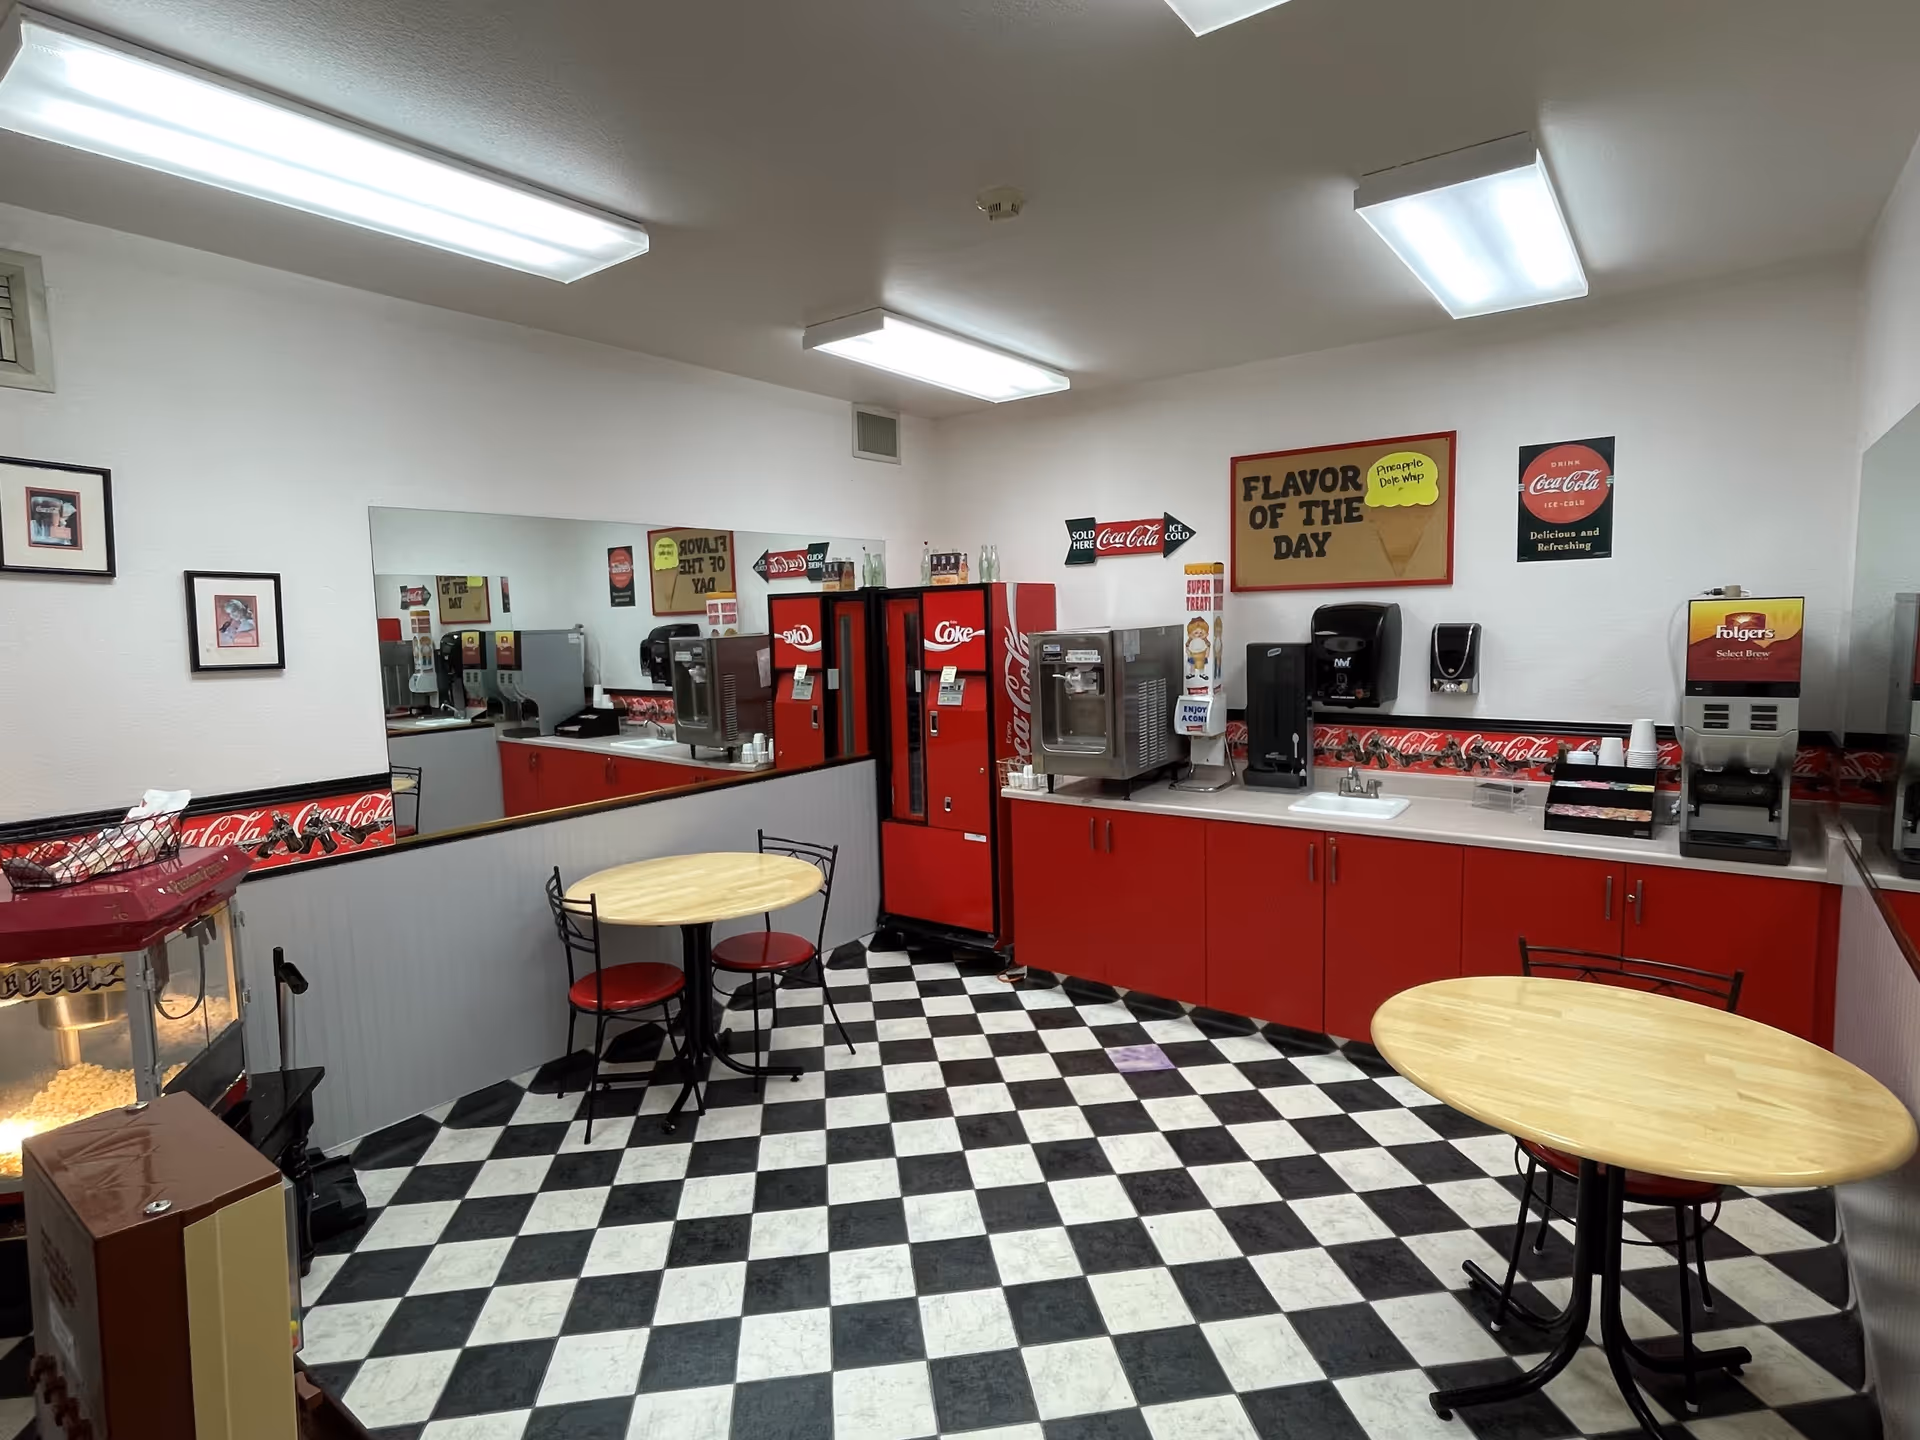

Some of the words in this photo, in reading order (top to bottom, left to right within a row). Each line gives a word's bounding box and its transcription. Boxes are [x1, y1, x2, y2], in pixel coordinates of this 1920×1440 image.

[1376, 458, 1424, 476] Pineapple
[1551, 460, 1580, 468] DRINK
[1243, 465, 1364, 501] FLAVOR
[1379, 475, 1400, 488] Dole
[1402, 473, 1424, 485] Whip
[1529, 469, 1603, 495] Coca-Cola
[1250, 502, 1286, 529] OF
[1299, 496, 1364, 526] THE
[1072, 530, 1095, 540] SOLD
[1096, 524, 1161, 550] Coca-Cola
[1165, 532, 1189, 541] COLD
[1169, 524, 1183, 533] ICE
[1530, 530, 1576, 540] Delicious
[1580, 527, 1600, 537] and
[1073, 540, 1095, 550] HERE
[1273, 532, 1332, 560] DAY
[1537, 541, 1592, 552] Refreshing
[1187, 579, 1210, 594] SUPER
[934, 620, 974, 643] Coke
[1716, 625, 1775, 642] Folgers
[1716, 649, 1743, 658] Select
[1746, 649, 1770, 658] Brew
[1184, 706, 1207, 714] ENJOY
[1359, 729, 1443, 755] Cca-Cola
[1460, 733, 1554, 761] Cca-Cola
[293, 791, 392, 829] Cca-Cola
[3, 965, 88, 994] RESH
